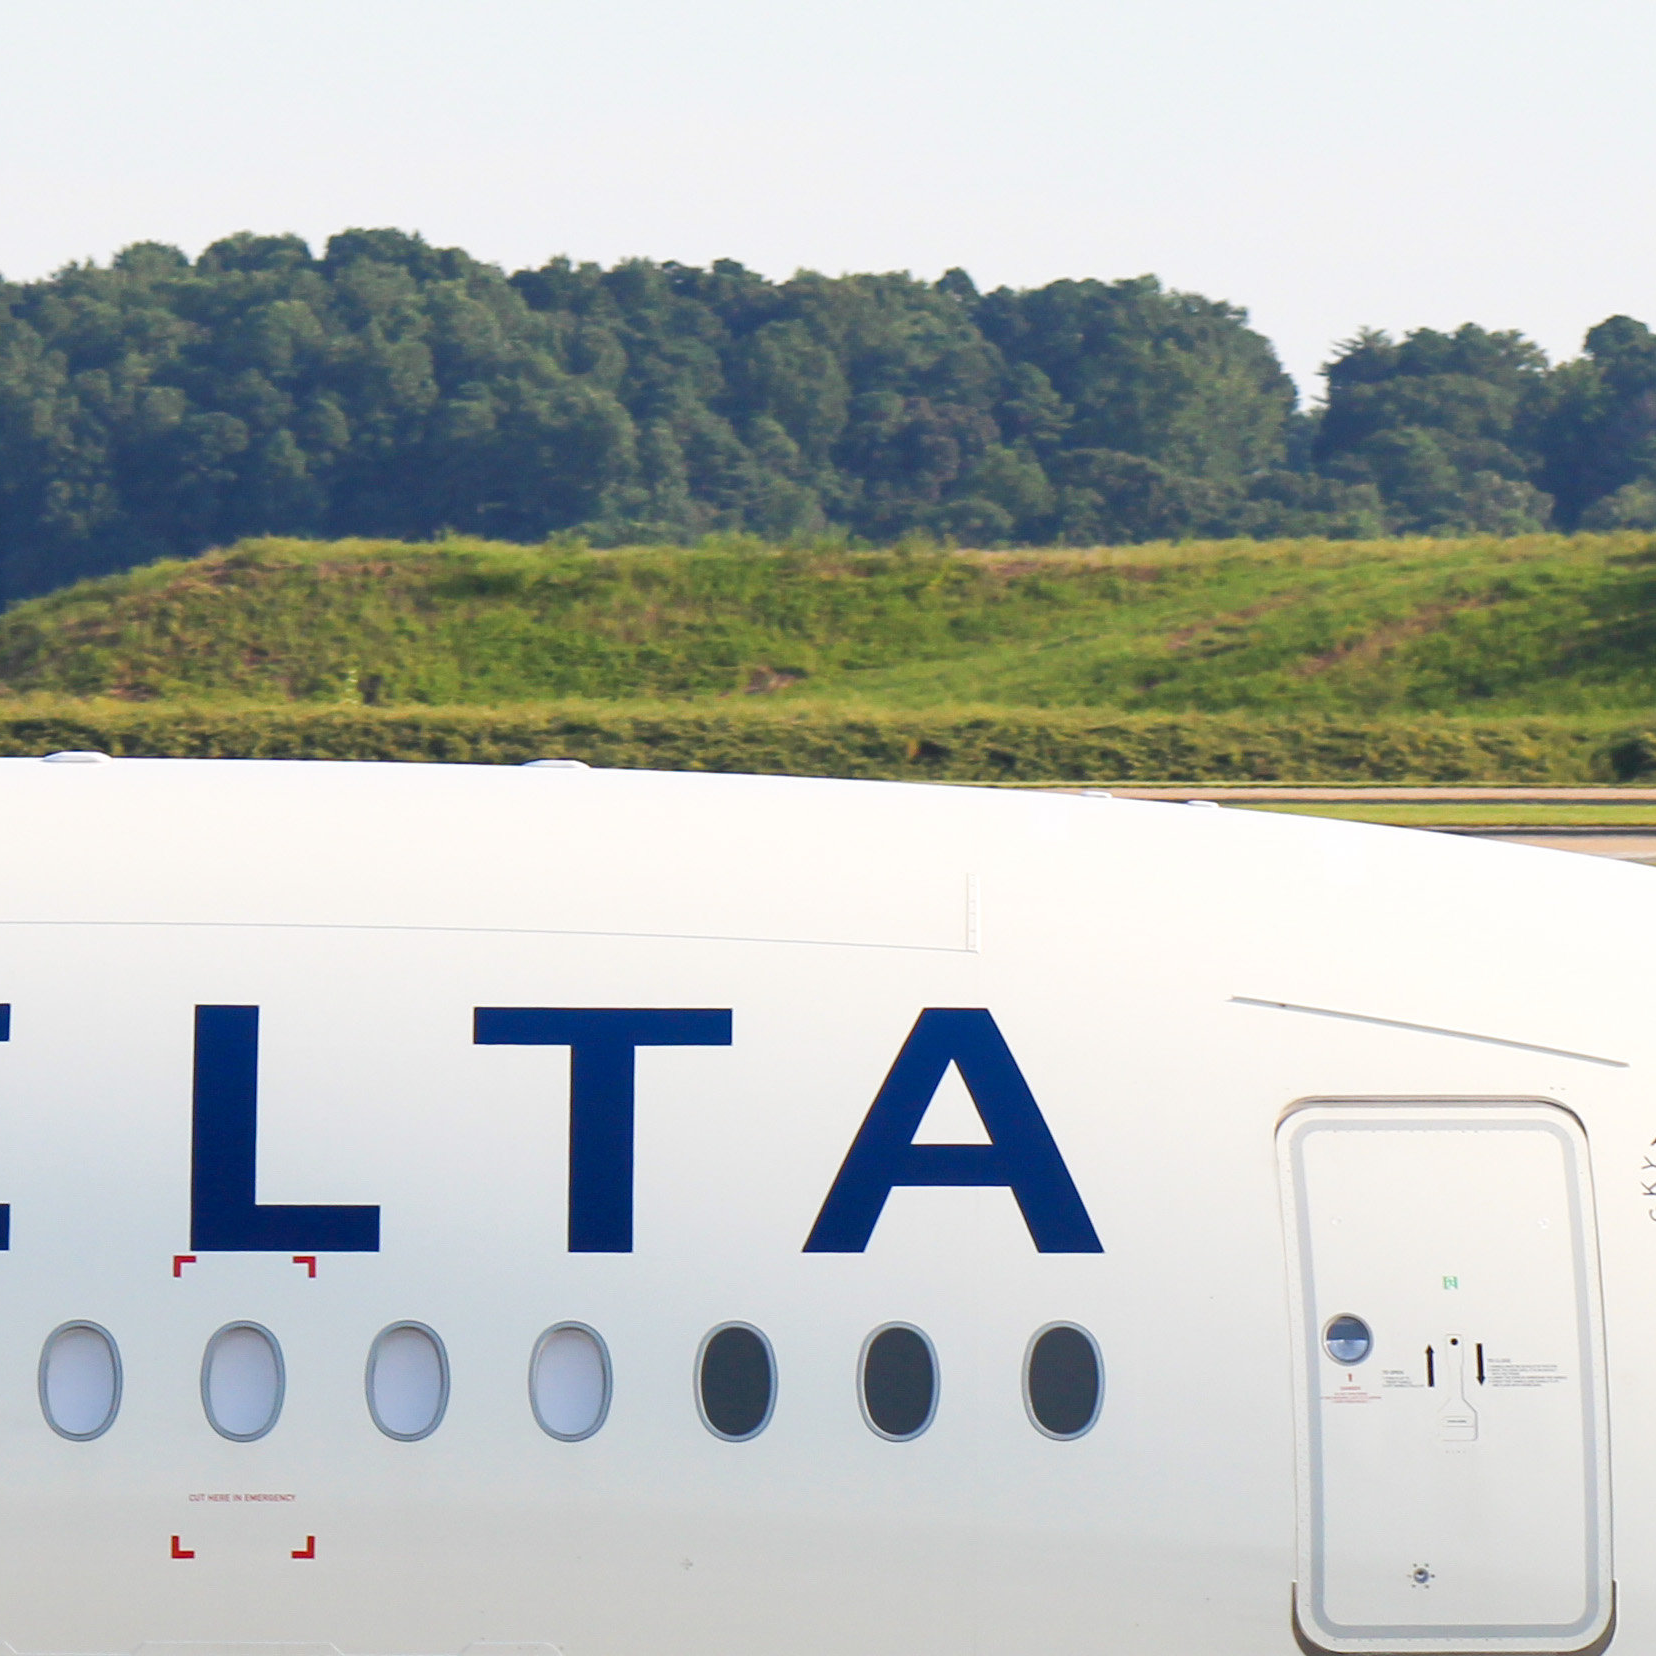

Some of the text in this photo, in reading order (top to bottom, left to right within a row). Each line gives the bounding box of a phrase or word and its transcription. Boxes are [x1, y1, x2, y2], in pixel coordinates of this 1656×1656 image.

[188, 1493, 296, 1502] CUT HERE IN EMERGENCY
